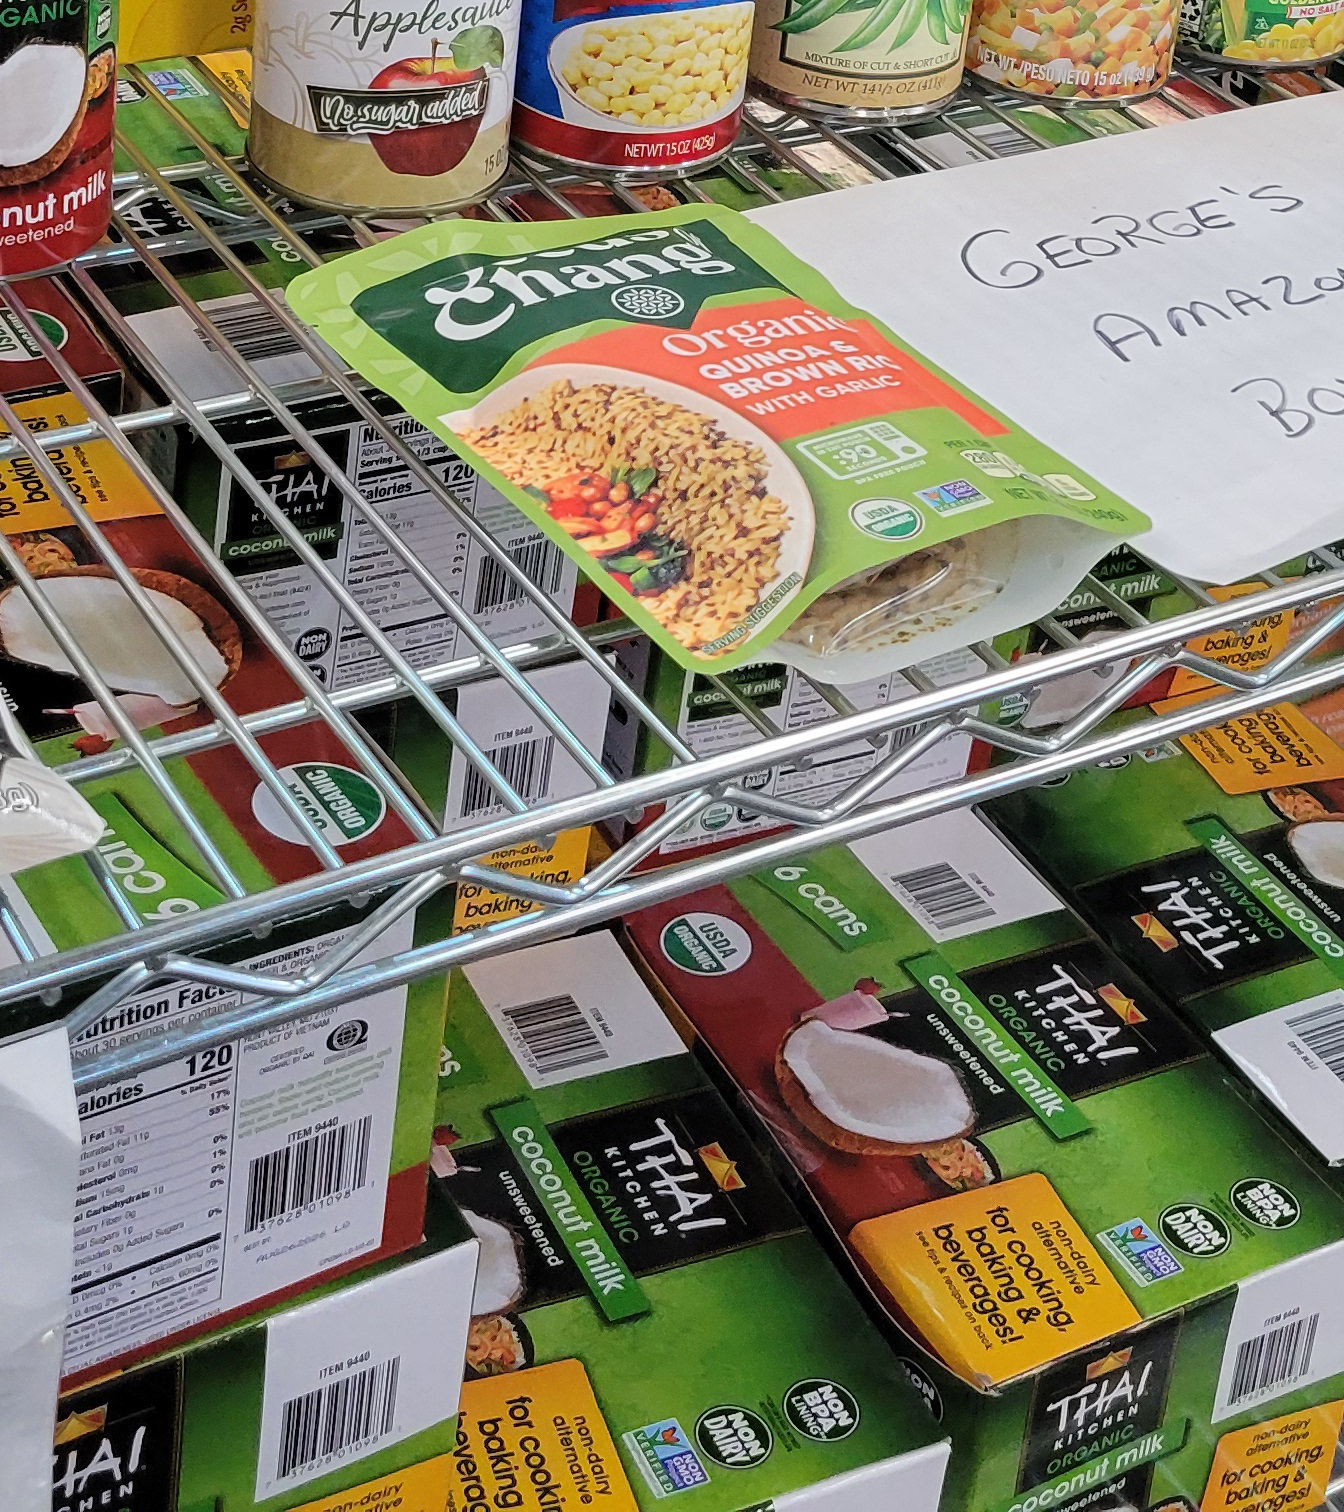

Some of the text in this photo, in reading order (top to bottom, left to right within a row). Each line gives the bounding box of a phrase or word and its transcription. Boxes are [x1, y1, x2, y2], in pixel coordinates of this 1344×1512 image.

[322, 80, 484, 133] No sugar added
[62, 169, 107, 214] milk
[959, 184, 1305, 289] GEORGE'S
[700, 344, 826, 381] QUINOA
[720, 365, 851, 402] BROWN
[743, 374, 902, 419] WITH GARLIC
[773, 865, 870, 939] 6 cans
[1036, 963, 1139, 1061] THAI
[185, 1045, 233, 1077] 120
[929, 975, 1066, 1117] coconut milk
[630, 1118, 727, 1233] THAI
[986, 1207, 1014, 1232] for
[932, 1224, 1024, 1345] beverages!
[966, 1229, 1024, 1304] baking
